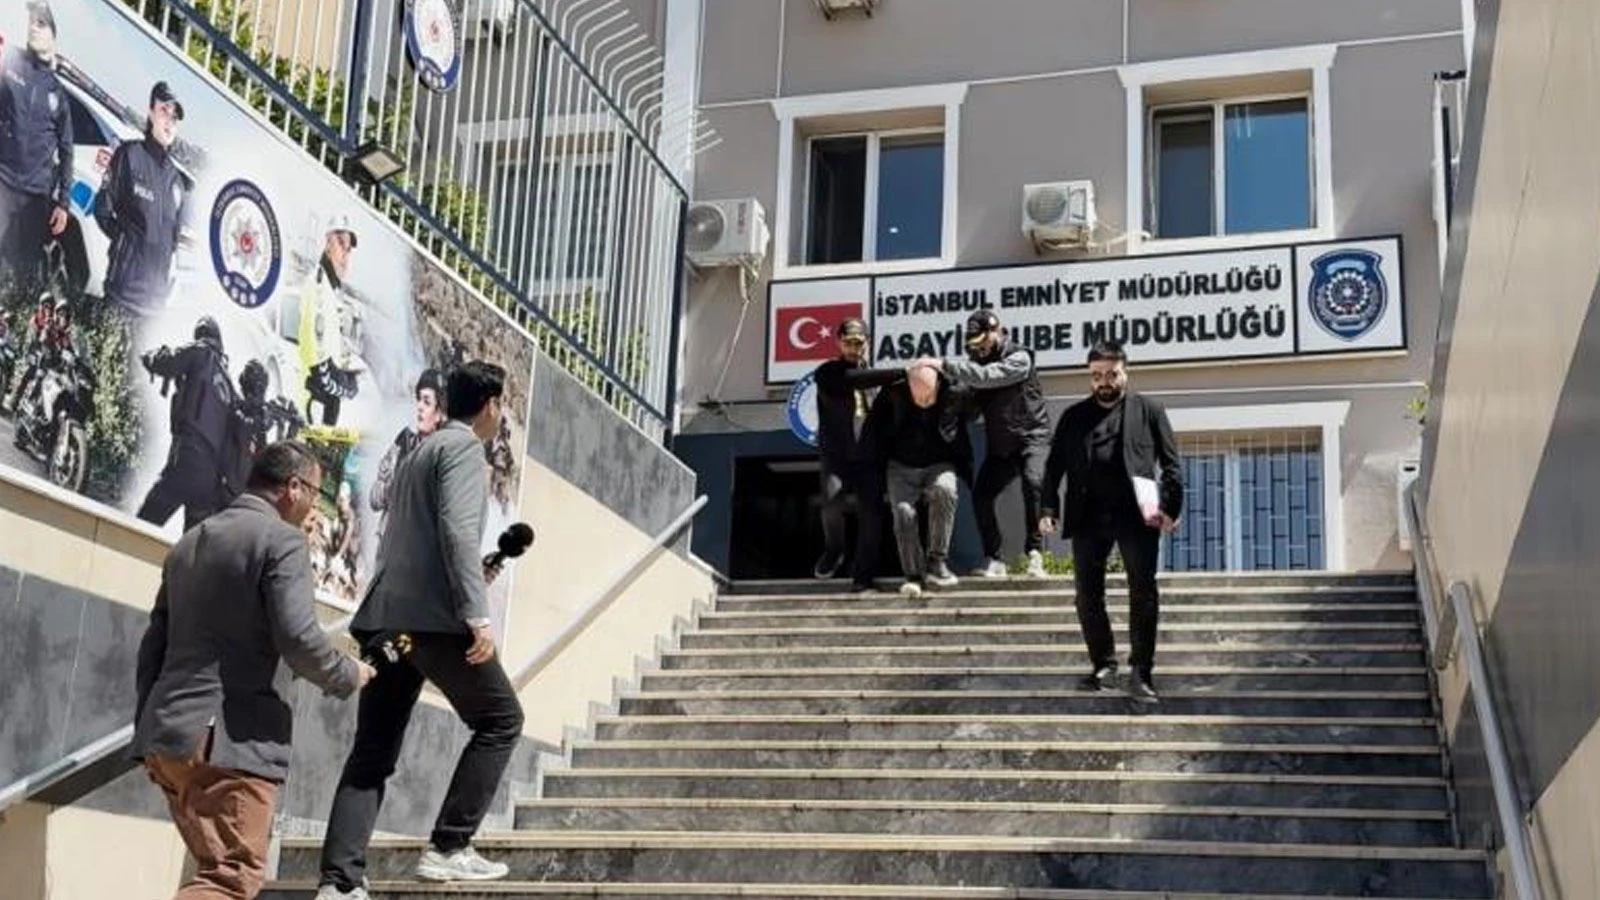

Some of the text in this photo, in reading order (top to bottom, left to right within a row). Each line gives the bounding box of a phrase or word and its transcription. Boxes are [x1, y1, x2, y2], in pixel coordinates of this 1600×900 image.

[877, 263, 1282, 317] İSTANBUL EMNİYET MÜDÜRLÜĞÜ
[877, 304, 1286, 361] ASAYİ UBE MÜDÜRLÜĞÜ
